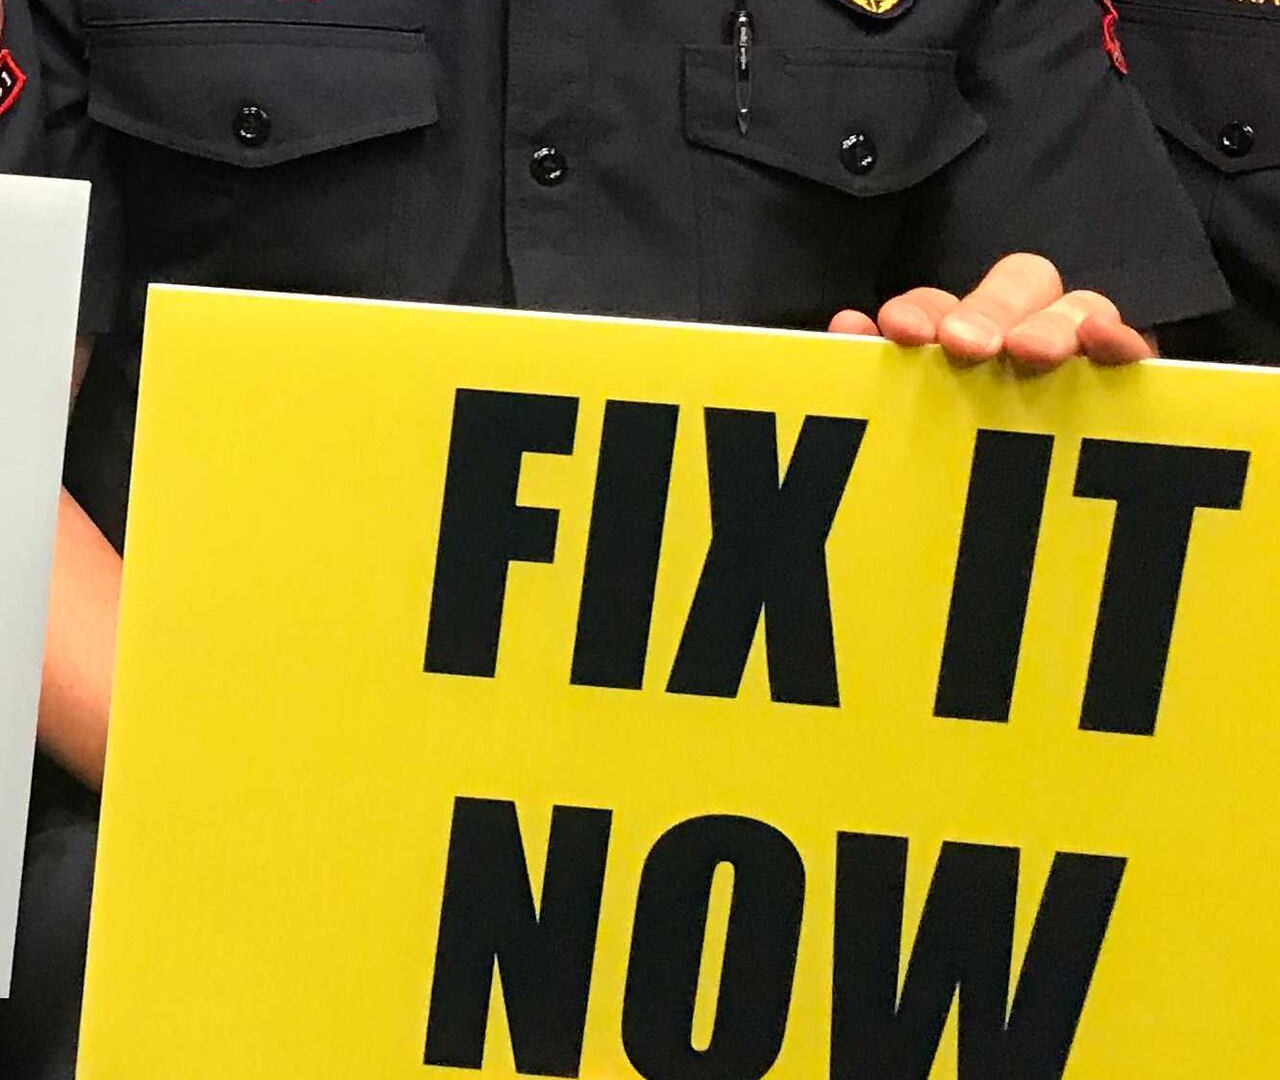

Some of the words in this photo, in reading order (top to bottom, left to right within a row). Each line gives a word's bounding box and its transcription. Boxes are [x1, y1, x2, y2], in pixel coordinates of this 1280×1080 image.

[424, 388, 869, 709] FIX
[932, 429, 1251, 737] IT
[424, 796, 1128, 1080] NOW
